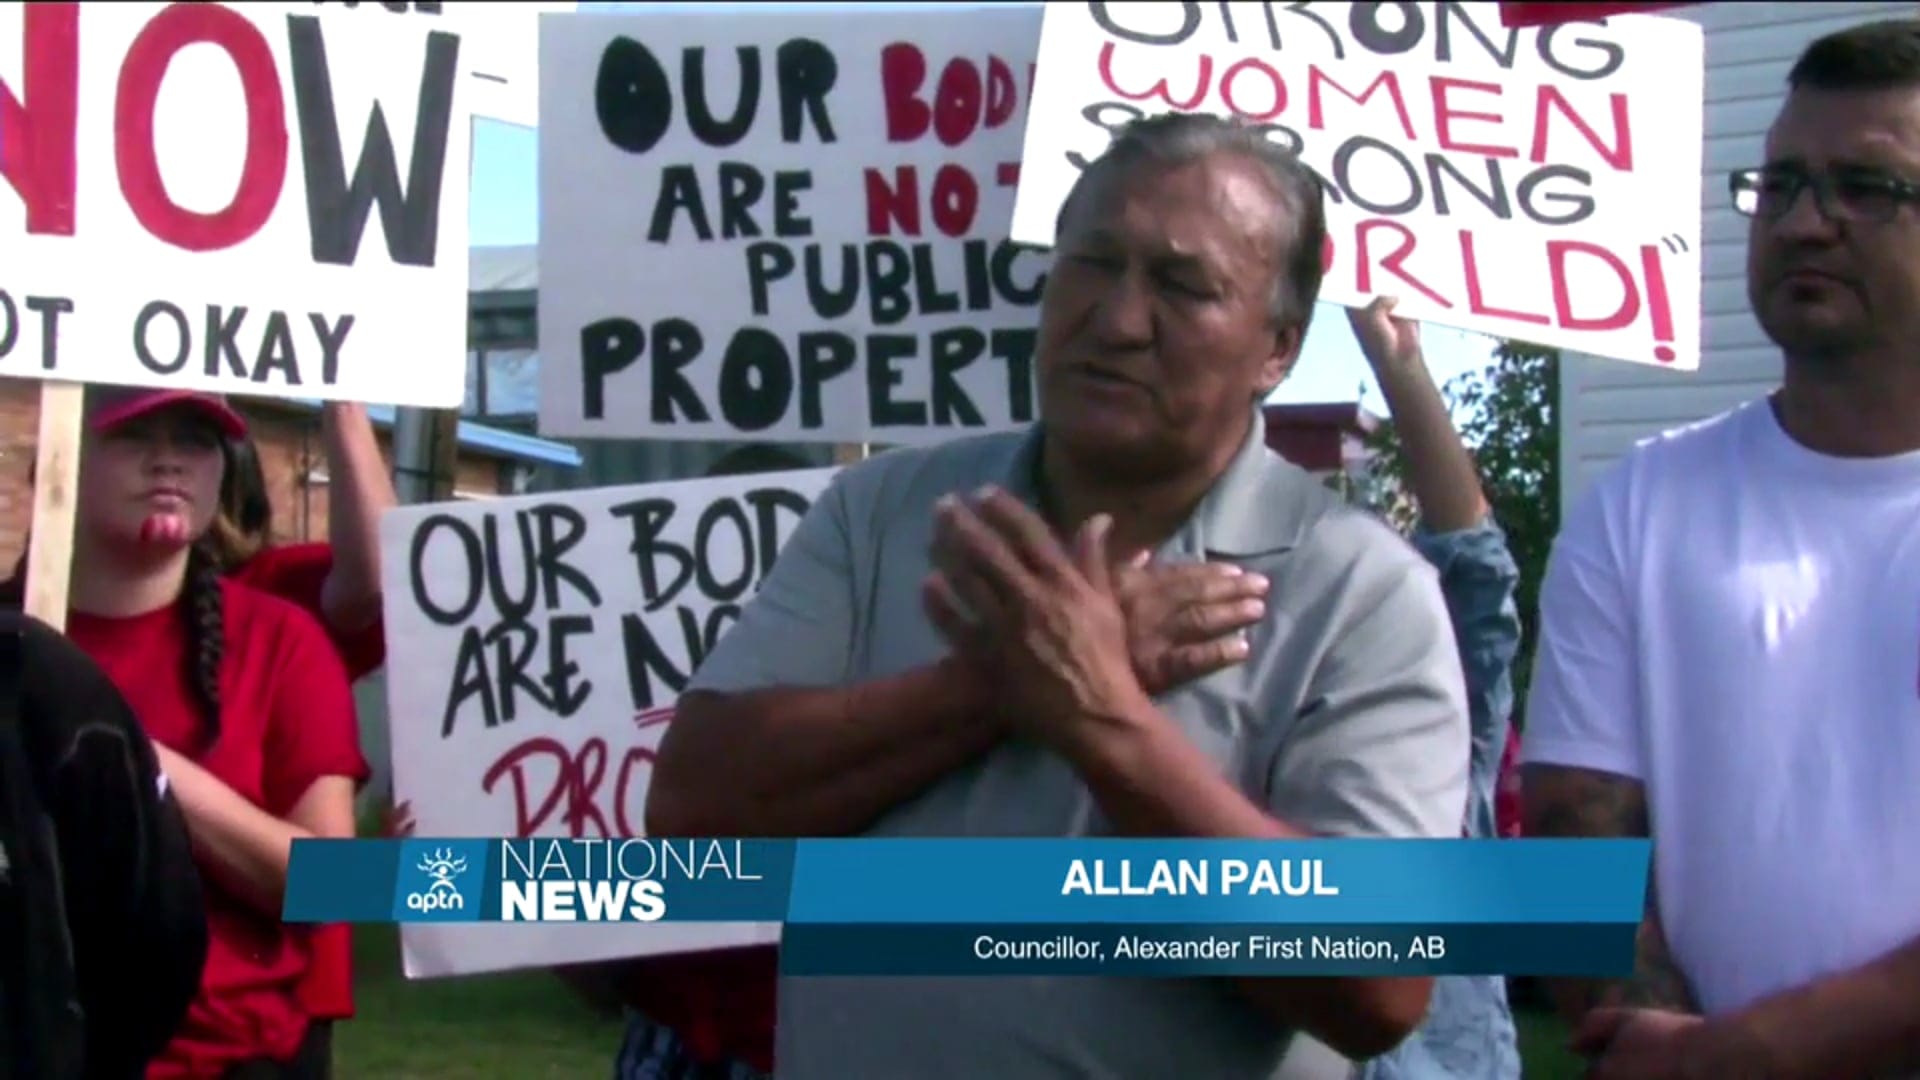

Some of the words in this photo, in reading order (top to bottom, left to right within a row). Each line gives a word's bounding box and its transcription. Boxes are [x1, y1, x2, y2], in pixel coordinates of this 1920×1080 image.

[595, 36, 837, 154] OUR
[881, 41, 1037, 147] BOD
[1098, 41, 1633, 172] WOMEN
[648, 162, 813, 243] ARE
[746, 240, 1047, 325] PUBLIC
[133, 300, 355, 385] OKAY
[410, 504, 602, 625] OUR
[442, 613, 593, 738] ARE
